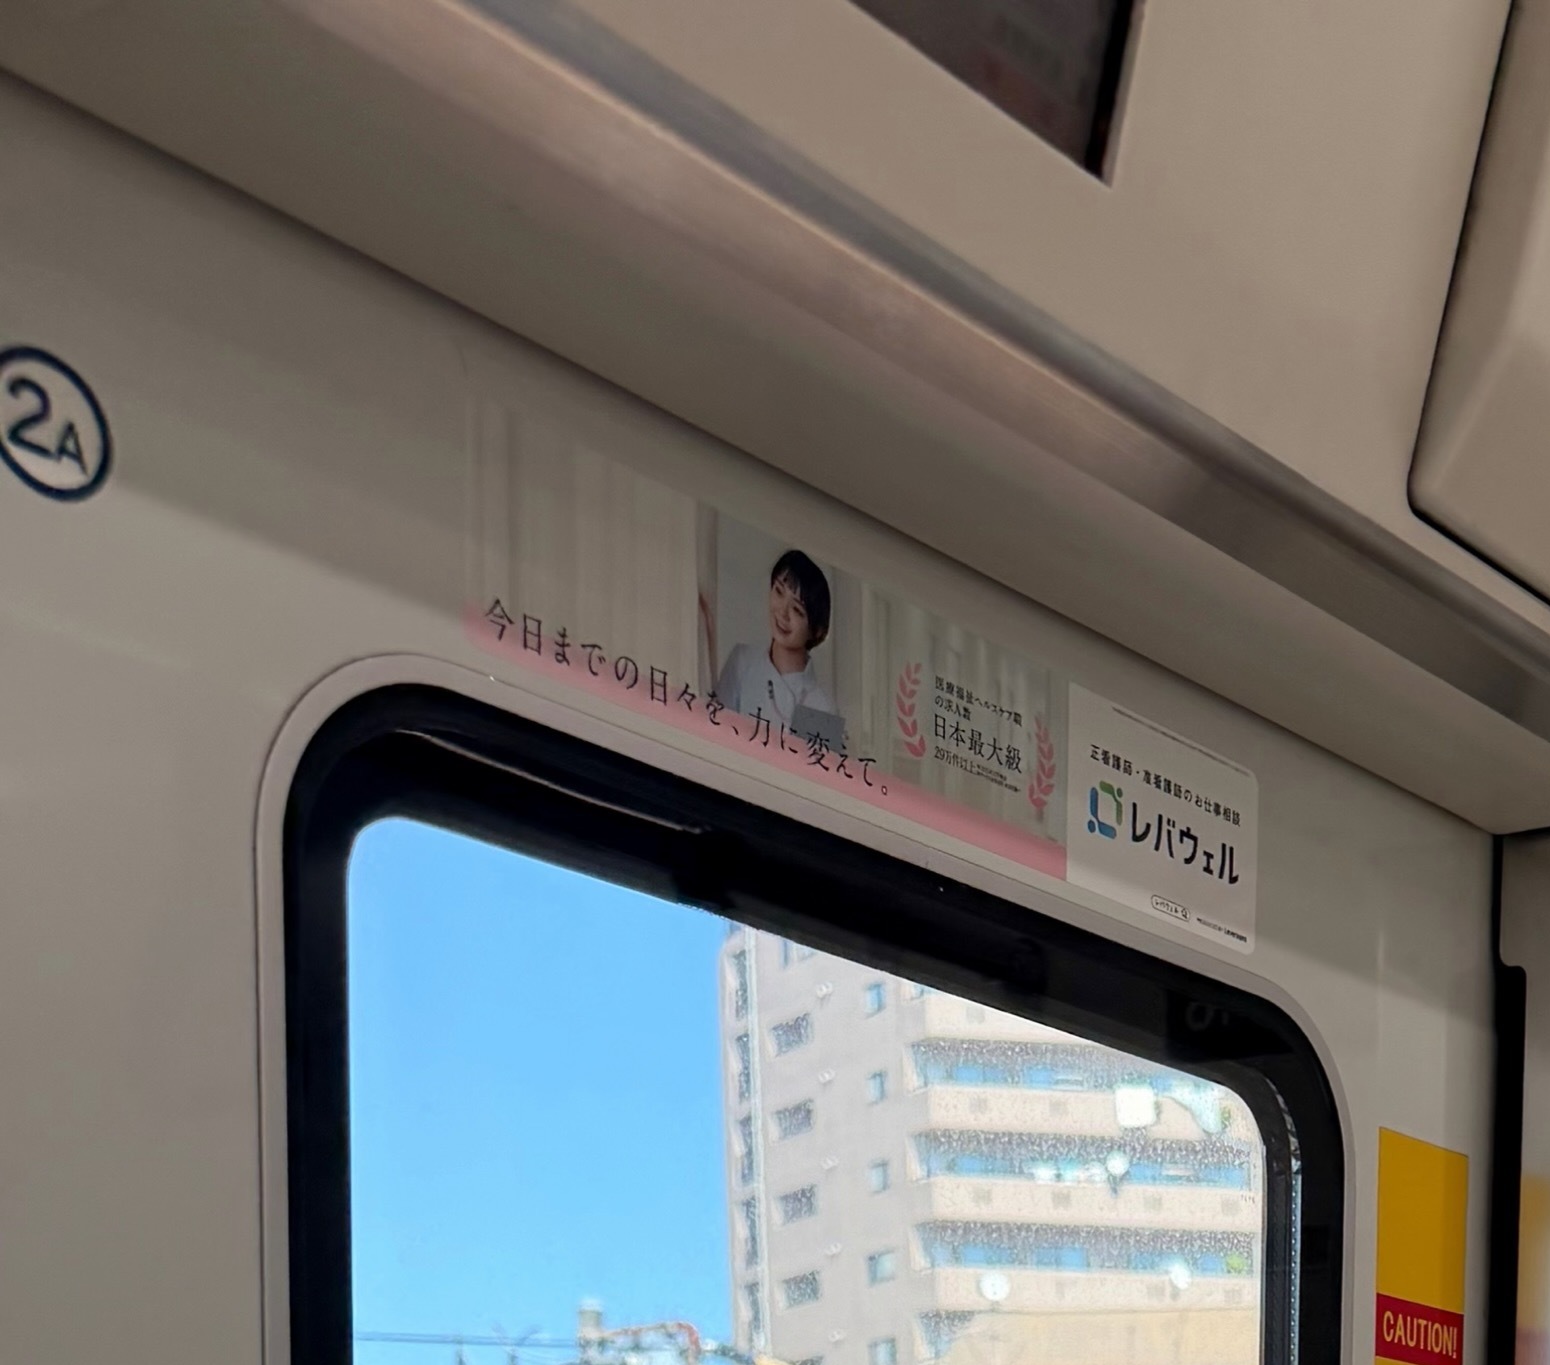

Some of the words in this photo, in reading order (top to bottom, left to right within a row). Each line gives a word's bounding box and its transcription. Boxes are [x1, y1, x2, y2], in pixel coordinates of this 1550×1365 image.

[7, 375, 89, 477] 2A
[485, 597, 888, 796] 今日までの日々を、力に変えて。
[935, 713, 1022, 774] 日本最大級
[1132, 801, 1239, 885] レバウェル
[1383, 1310, 1458, 1359] CAUTION!
